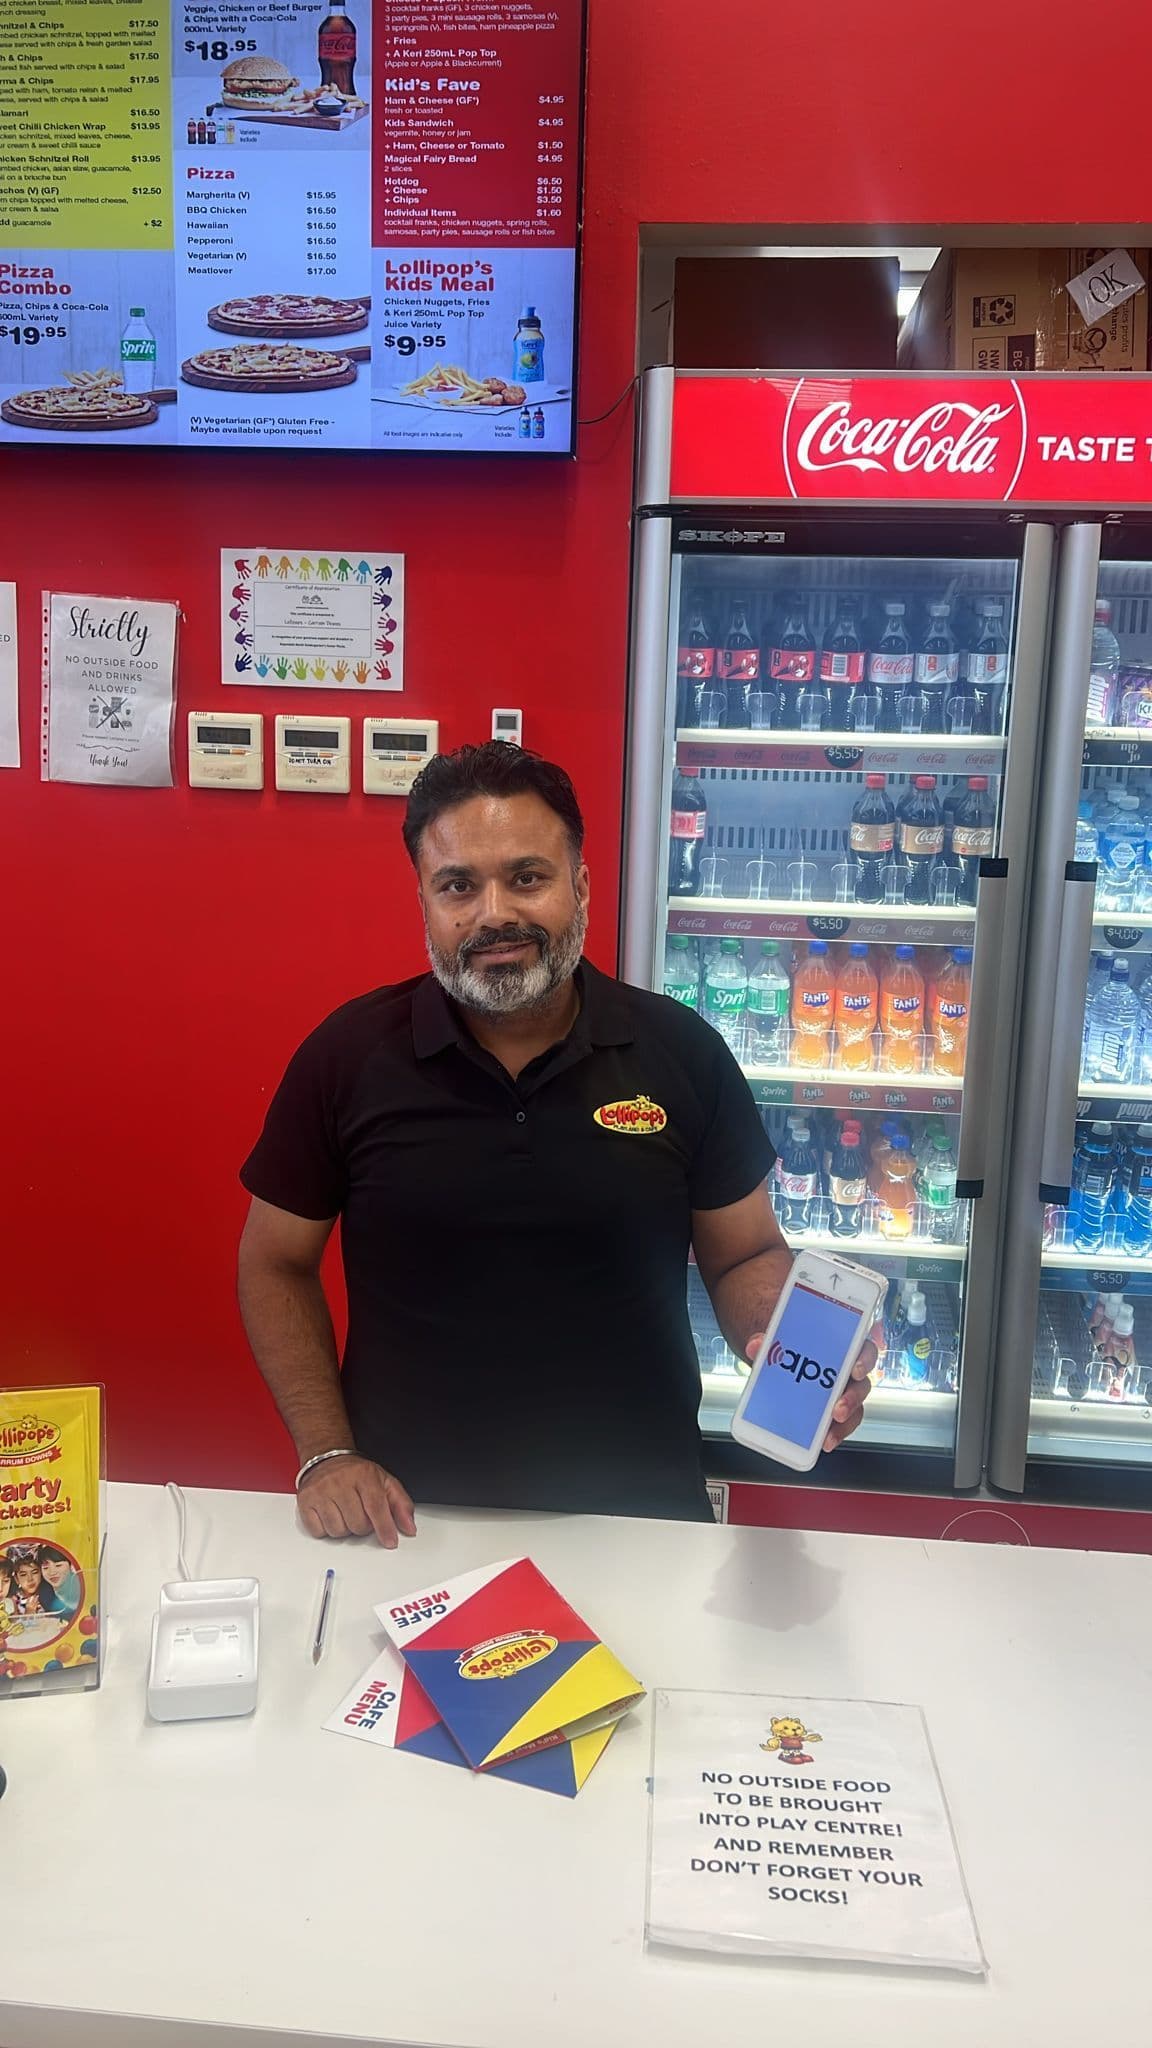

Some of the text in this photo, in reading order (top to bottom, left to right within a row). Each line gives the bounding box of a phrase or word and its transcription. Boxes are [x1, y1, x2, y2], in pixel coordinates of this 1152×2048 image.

[184, 5, 216, 14] Veggie,
[269, 4, 290, 12] Beef
[292, 4, 322, 12] Burger
[129, 20, 159, 28] $17.50
[393, 37, 417, 45] Fries
[129, 52, 159, 61] $17.50
[185, 40, 257, 61] $18.95
[403, 50, 422, 58] Keri
[425, 49, 456, 58] 250mL
[458, 49, 478, 58] Pop
[480, 49, 497, 58] Top
[130, 76, 160, 84] $17.95
[385, 78, 481, 91] Kid's Fave
[418, 96, 453, 105] Cheese
[538, 96, 565, 104] $4.95
[130, 109, 160, 117] $16.50
[130, 122, 160, 130] $13.95
[385, 119, 564, 127] Kids Sandwich $4.95
[393, 142, 417, 150] Ham,
[420, 142, 455, 150] Cheese
[470, 142, 505, 150] Tomato
[537, 142, 563, 150] $1.50
[131, 155, 161, 163] $13.95
[384, 155, 563, 164] Magical Fairy Bread $4.95
[187, 167, 235, 180] Pizza
[384, 177, 562, 187] Hotdog $6.50
[132, 187, 162, 195] $12.50
[186, 191, 236, 200] Margherita
[238, 191, 250, 200] (V)
[537, 186, 562, 194] $1.50
[393, 196, 420, 205] Chips
[536, 196, 562, 204] $3.50
[306, 207, 336, 215] $16.50
[384, 209, 562, 217] Individual Items $1.60
[151, 219, 162, 227] $2
[306, 222, 336, 230] $16.50
[188, 237, 336, 245] Pepperoni $16.50
[187, 252, 234, 260] Vegetarian
[235, 252, 247, 261] (V)
[0, 264, 54, 279] Pizza
[188, 267, 233, 275] Meatlover
[385, 260, 493, 278] Lollipop's
[0, 280, 72, 295] Combo
[385, 277, 494, 291] Kids Meal
[1088, 263, 1129, 304] OK
[25, 303, 51, 311] Chips
[62, 303, 109, 311] Coca-Cola
[384, 298, 490, 307] Chicken Nuggets, Fries
[447, 310, 465, 318] Pop
[468, 310, 485, 318] Top
[411, 321, 442, 330] Variety
[0, 326, 67, 345] $19.95
[122, 341, 155, 357] Sprite
[384, 334, 447, 356] $9.95
[797, 402, 1135, 473] Coca-Cola TASTE
[70, 606, 151, 657] Strictly
[65, 655, 159, 670] NO OUTSIDE FOOD
[872, 657, 913, 675] Coca-Cola
[81, 670, 143, 682] AND DRINKS
[88, 684, 137, 695] ALLOWED
[828, 746, 859, 760] $5.50
[813, 917, 843, 930] $5.50
[1107, 927, 1139, 940] $4.00
[664, 985, 698, 1001] Sprit
[803, 992, 830, 1004] FANTA
[843, 996, 871, 1007] FANTA
[893, 997, 920, 1009] FANTA
[940, 1002, 967, 1015] FANTA
[1100, 1031, 1125, 1076] pump
[761, 1086, 787, 1096] Sprite
[802, 1088, 824, 1099] FANTA
[849, 1091, 871, 1101] FANTA
[885, 1094, 907, 1103] FANTA
[932, 1096, 955, 1106] FANTA
[600, 1104, 664, 1126] Lollipop's
[916, 1263, 942, 1273] Sprite
[1092, 1272, 1123, 1284] $5.50
[780, 1350, 837, 1389] aps
[0, 1424, 55, 1447] llipop's
[25, 1450, 53, 1464] DOWNS
[0, 1496, 71, 1520] ckages!
[390, 1590, 451, 1619] MENU
[394, 1603, 447, 1629] CAFE
[468, 1638, 552, 1675] Lollipop's
[343, 1680, 387, 1726] MENU
[357, 1691, 397, 1730] CAFE
[701, 1772, 891, 1793] NO OUTSIDE FOOD
[713, 1792, 883, 1814] TO BE BROUGHT
[699, 1812, 903, 1838] INTO PLAY CENTRE!
[713, 1837, 894, 1861] AND REMEMBER
[690, 1858, 923, 1887] DON'T FORGET YOUR
[768, 1886, 848, 1905] SOCKS!
